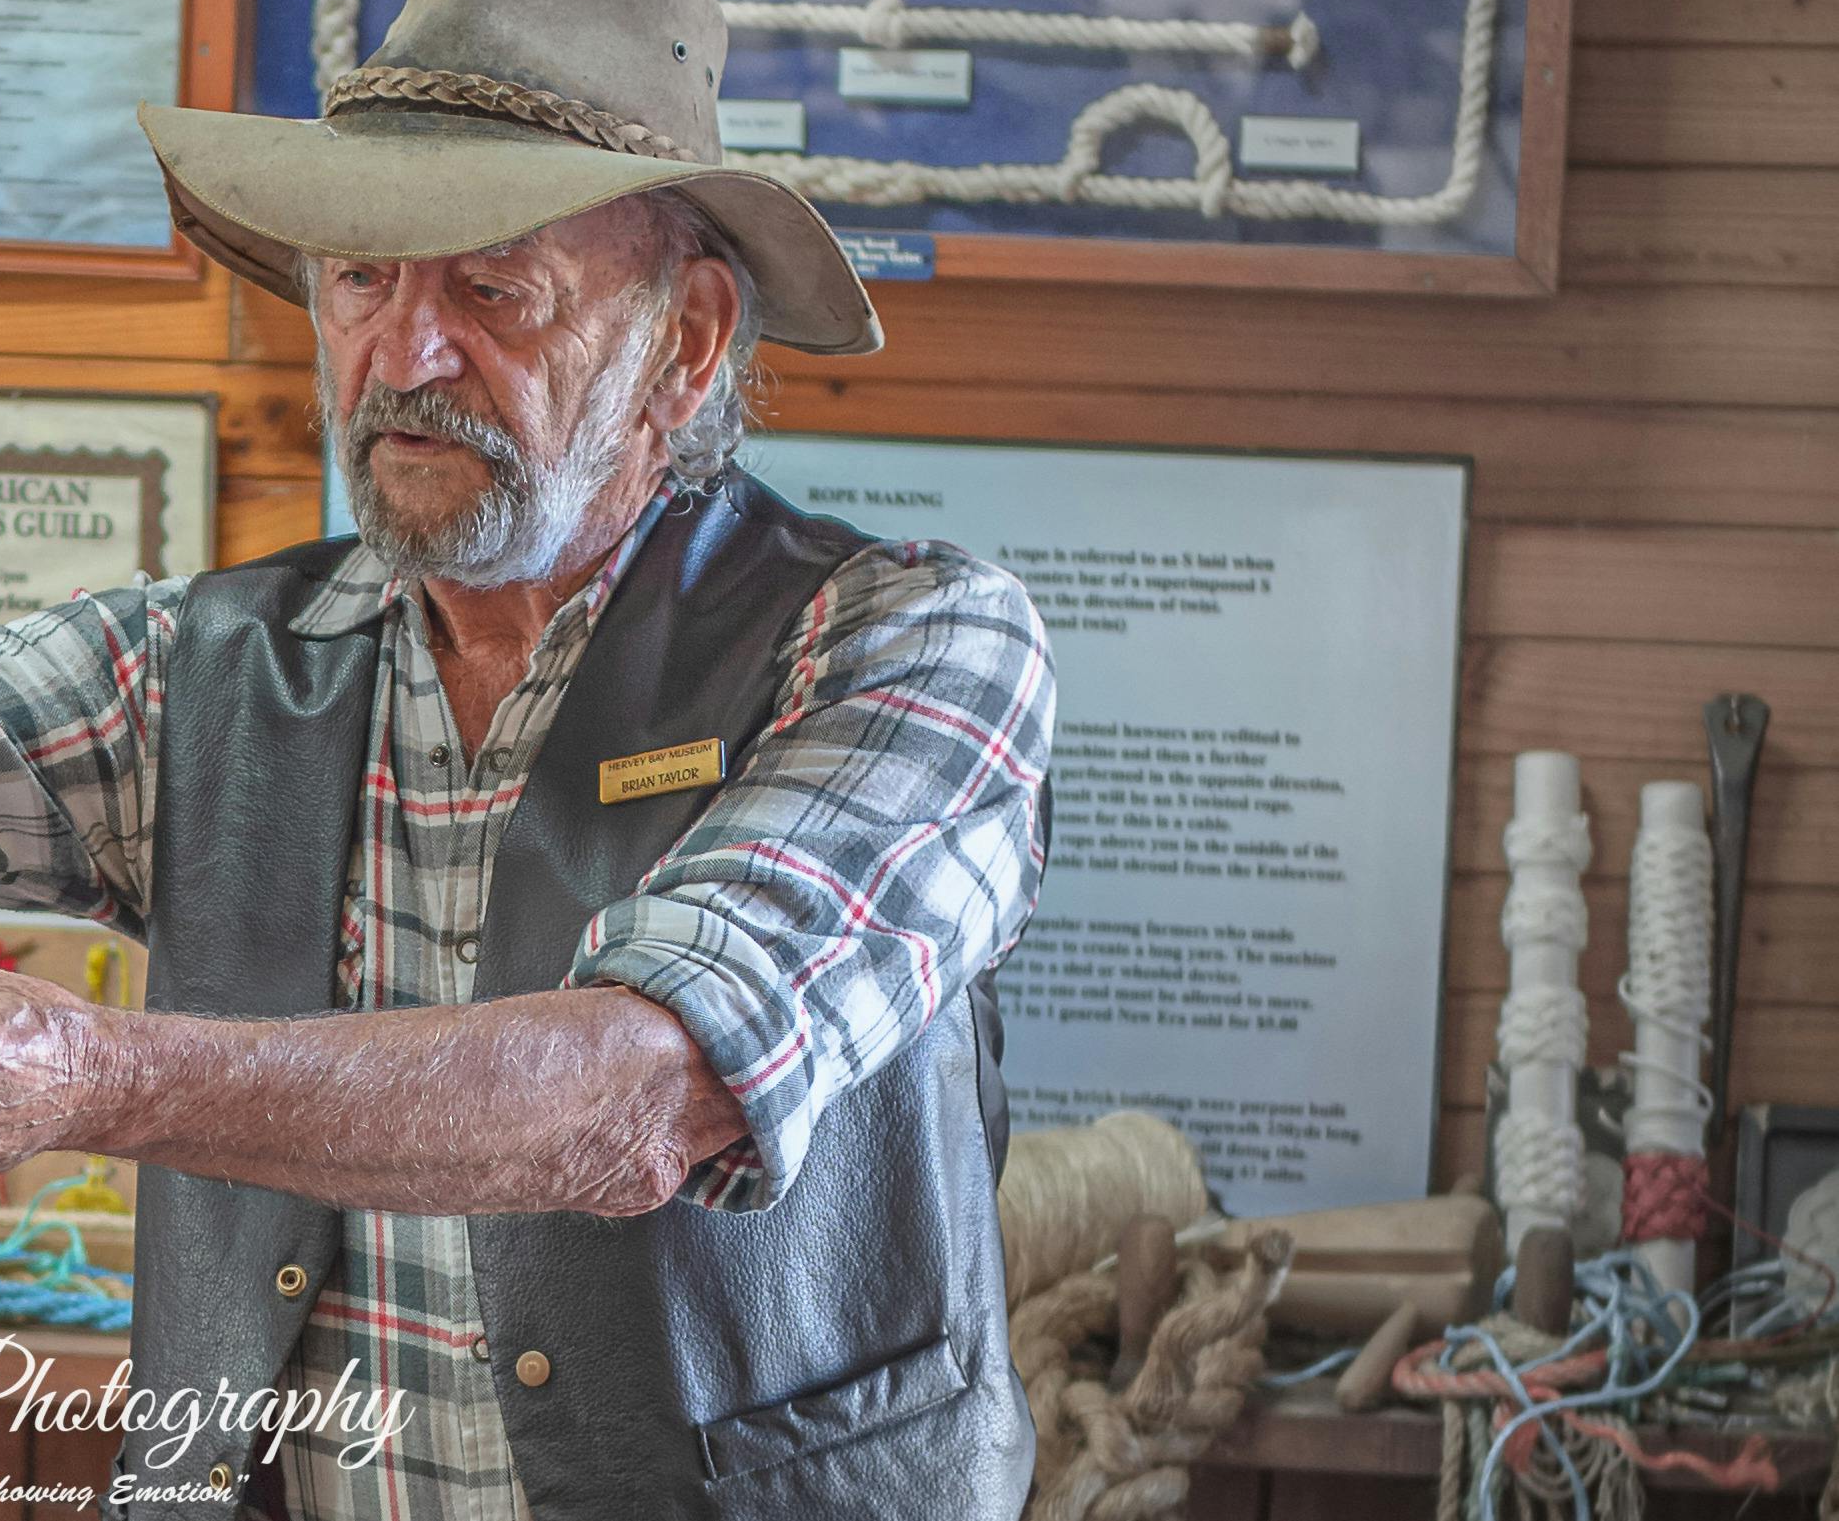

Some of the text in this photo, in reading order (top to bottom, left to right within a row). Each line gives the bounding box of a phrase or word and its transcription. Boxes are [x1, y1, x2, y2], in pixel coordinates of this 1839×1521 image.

[806, 486, 943, 507] ROPE MAKING
[13, 511, 115, 541] GUILD
[997, 545, 1274, 571] A rope is referred to as S laid when
[1023, 570, 1074, 590] centre
[1078, 570, 1105, 586] bar
[1110, 571, 1127, 587] of
[1131, 576, 1139, 587] a
[1144, 575, 1255, 595] superimposed
[1055, 592, 1079, 607] the
[1084, 593, 1154, 611] direction
[1159, 596, 1175, 612] of
[1059, 719, 1118, 737] twisted
[1122, 724, 1187, 740] hawsers
[1191, 729, 1216, 742] are
[1284, 732, 1300, 746] to
[607, 744, 713, 772] HERVEY BAY MUSEUM
[1121, 745, 1151, 761] and
[1155, 747, 1191, 763] then
[1195, 752, 1205, 764] a
[1209, 749, 1267, 766] further
[621, 767, 700, 794] BRIAN TAYLOR
[1057, 765, 1144, 785] performed
[1148, 769, 1164, 785] in
[1168, 770, 1193, 786] the
[1197, 773, 1265, 790] opposite
[1059, 833, 1339, 859] rope above you in the middle of the
[1088, 855, 1119, 872] laid
[1123, 857, 1179, 874] shroud
[1183, 859, 1222, 876] from
[1226, 862, 1251, 877] the
[1087, 921, 1294, 943] among farmers who made
